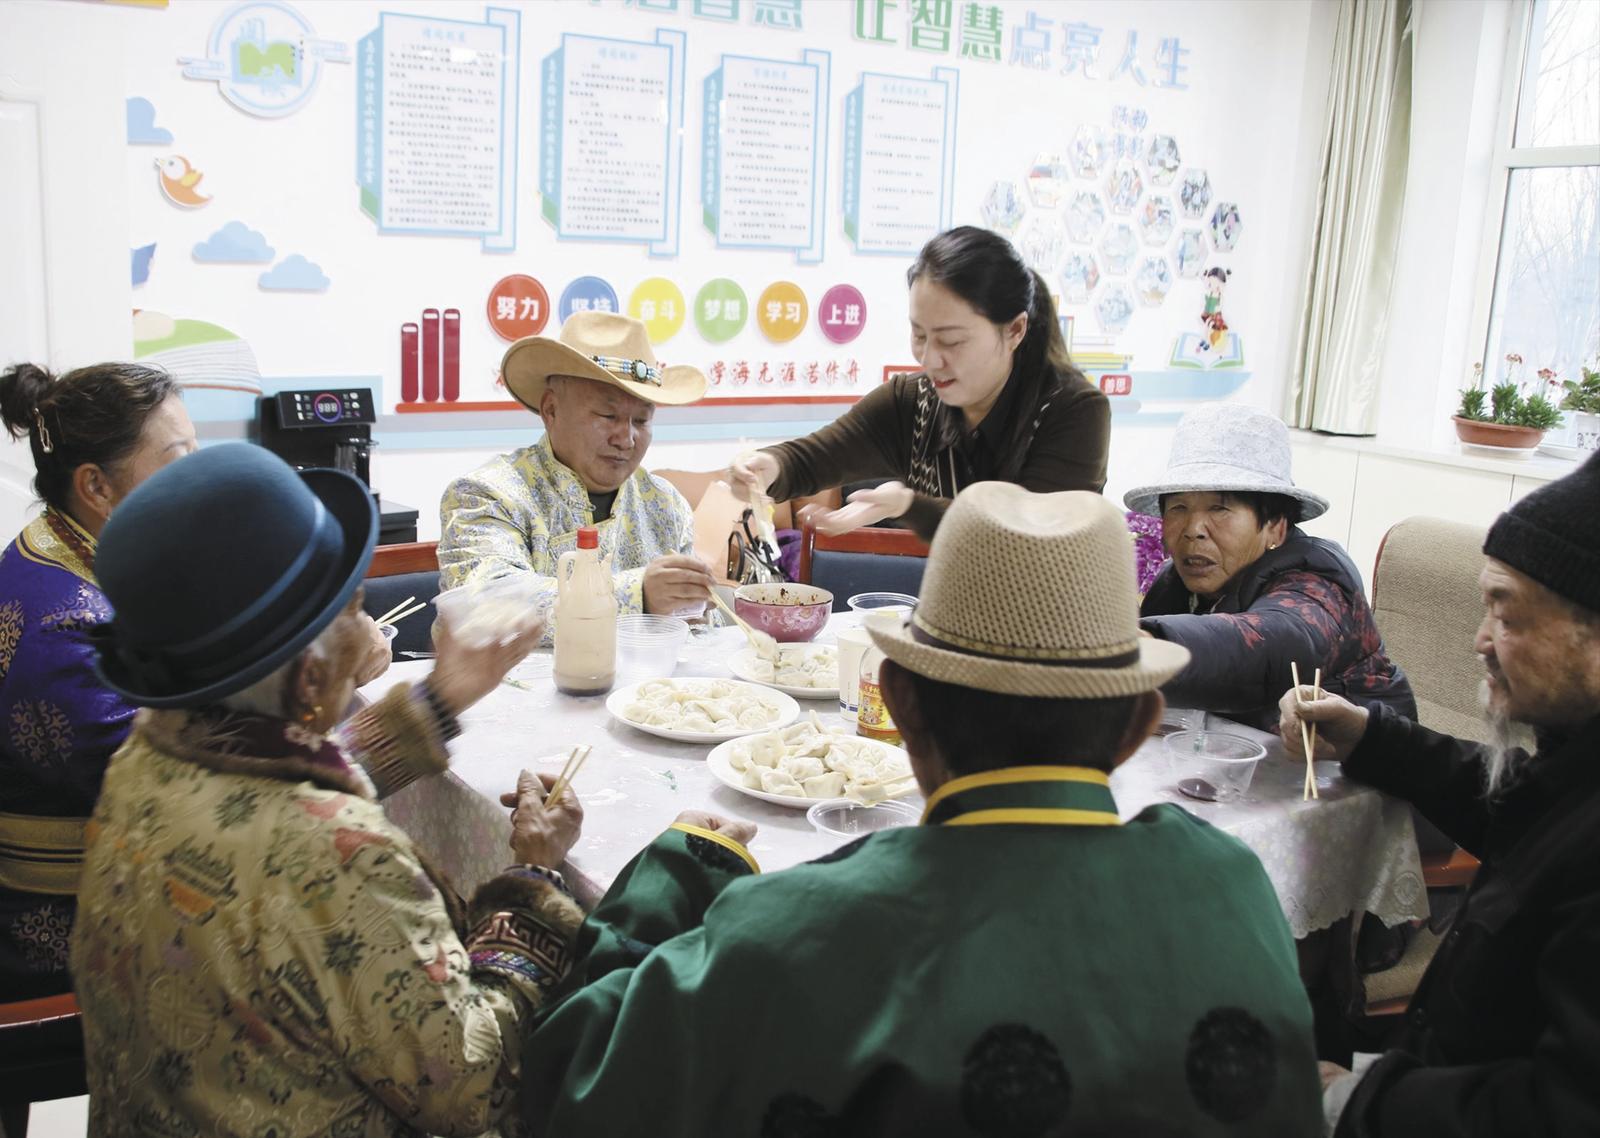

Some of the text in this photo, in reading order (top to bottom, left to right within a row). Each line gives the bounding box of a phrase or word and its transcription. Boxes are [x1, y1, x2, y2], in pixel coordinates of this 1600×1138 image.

[853, 0, 1191, 90] 让智慧点亮人生
[496, 296, 539, 321] 努力
[639, 299, 676, 321] 奋斗
[704, 298, 741, 322] 梦想
[765, 299, 802, 322] 学习
[826, 302, 862, 325] 上进
[708, 360, 861, 385] 学海无涯苦作舟
